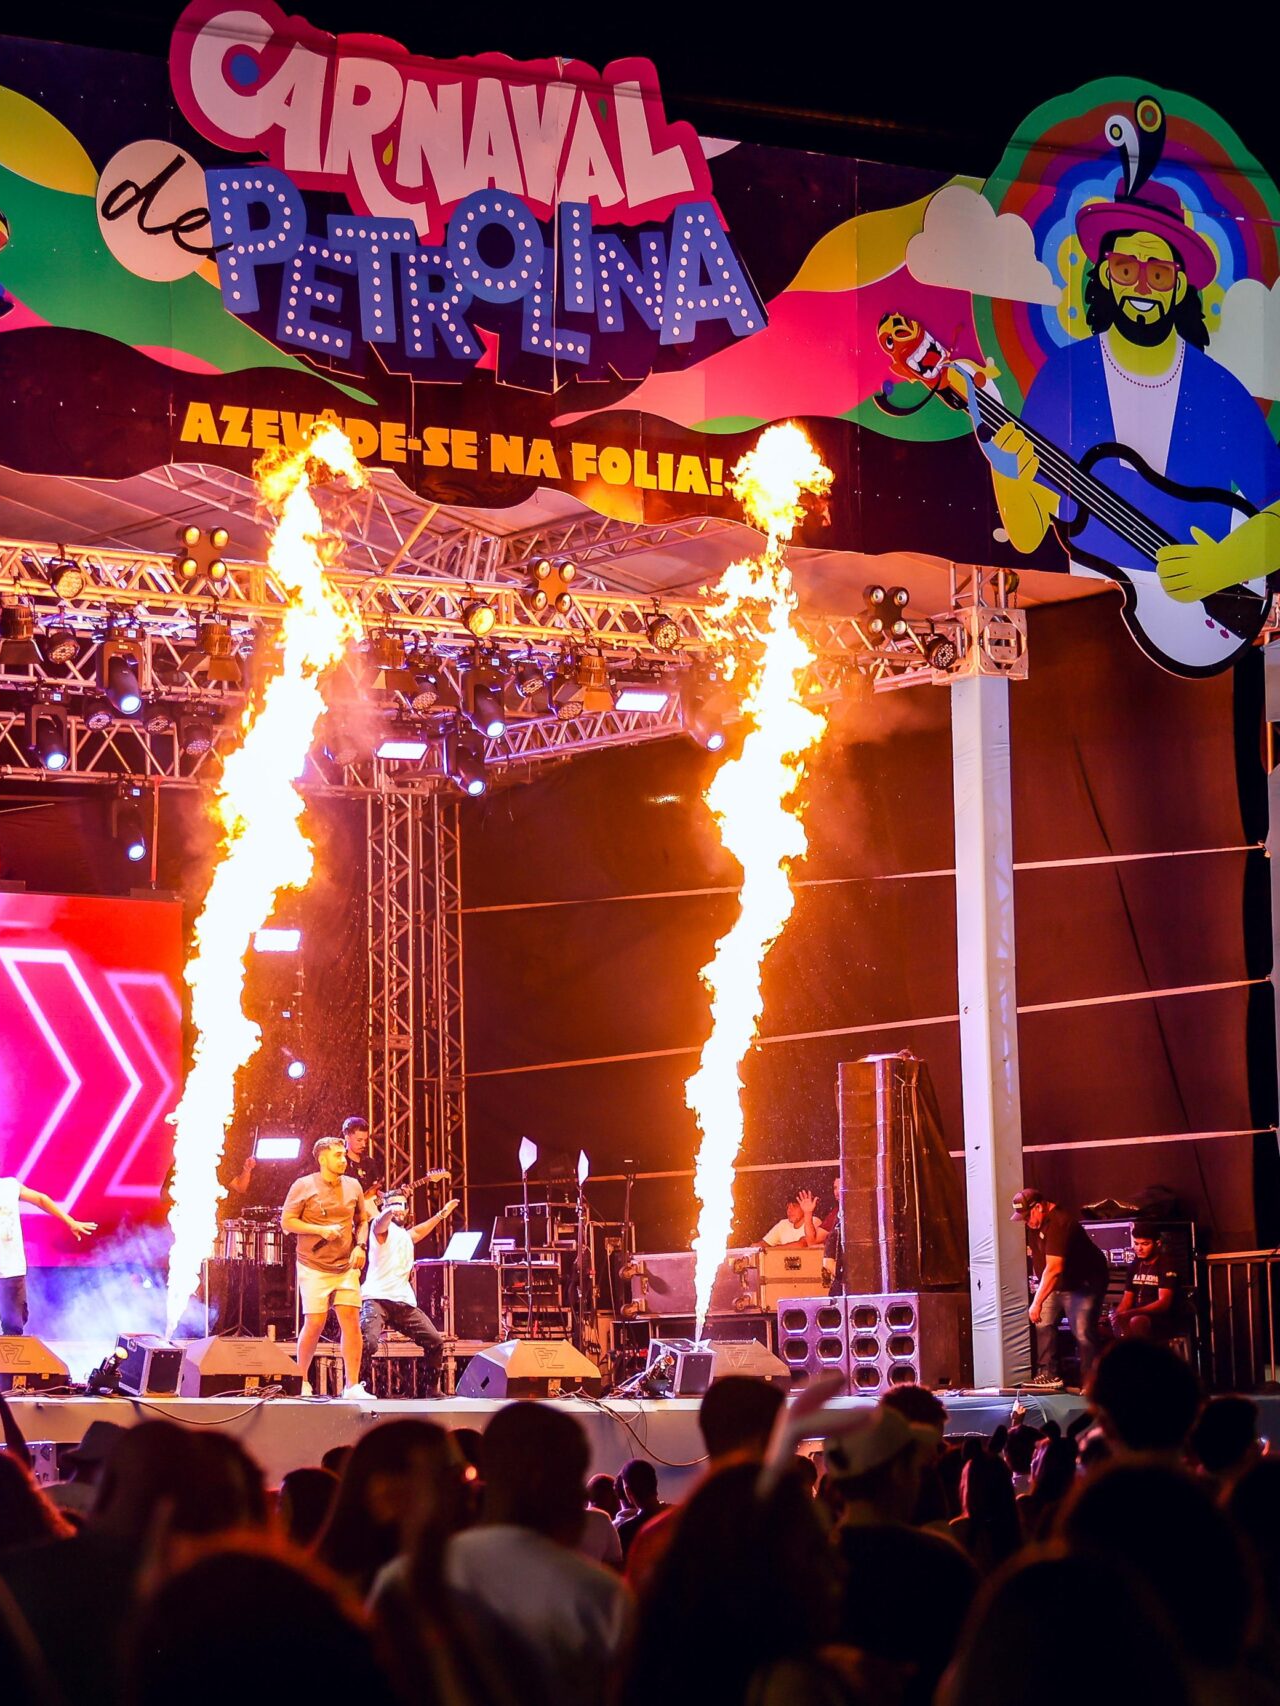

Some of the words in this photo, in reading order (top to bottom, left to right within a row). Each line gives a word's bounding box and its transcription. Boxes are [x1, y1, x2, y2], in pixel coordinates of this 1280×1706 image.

[189, 9, 695, 237] CARNAVAL
[100, 153, 233, 257] de
[204, 168, 769, 359] PETROLINA
[490, 432, 559, 479] NA
[572, 442, 725, 496] FOLIA!
